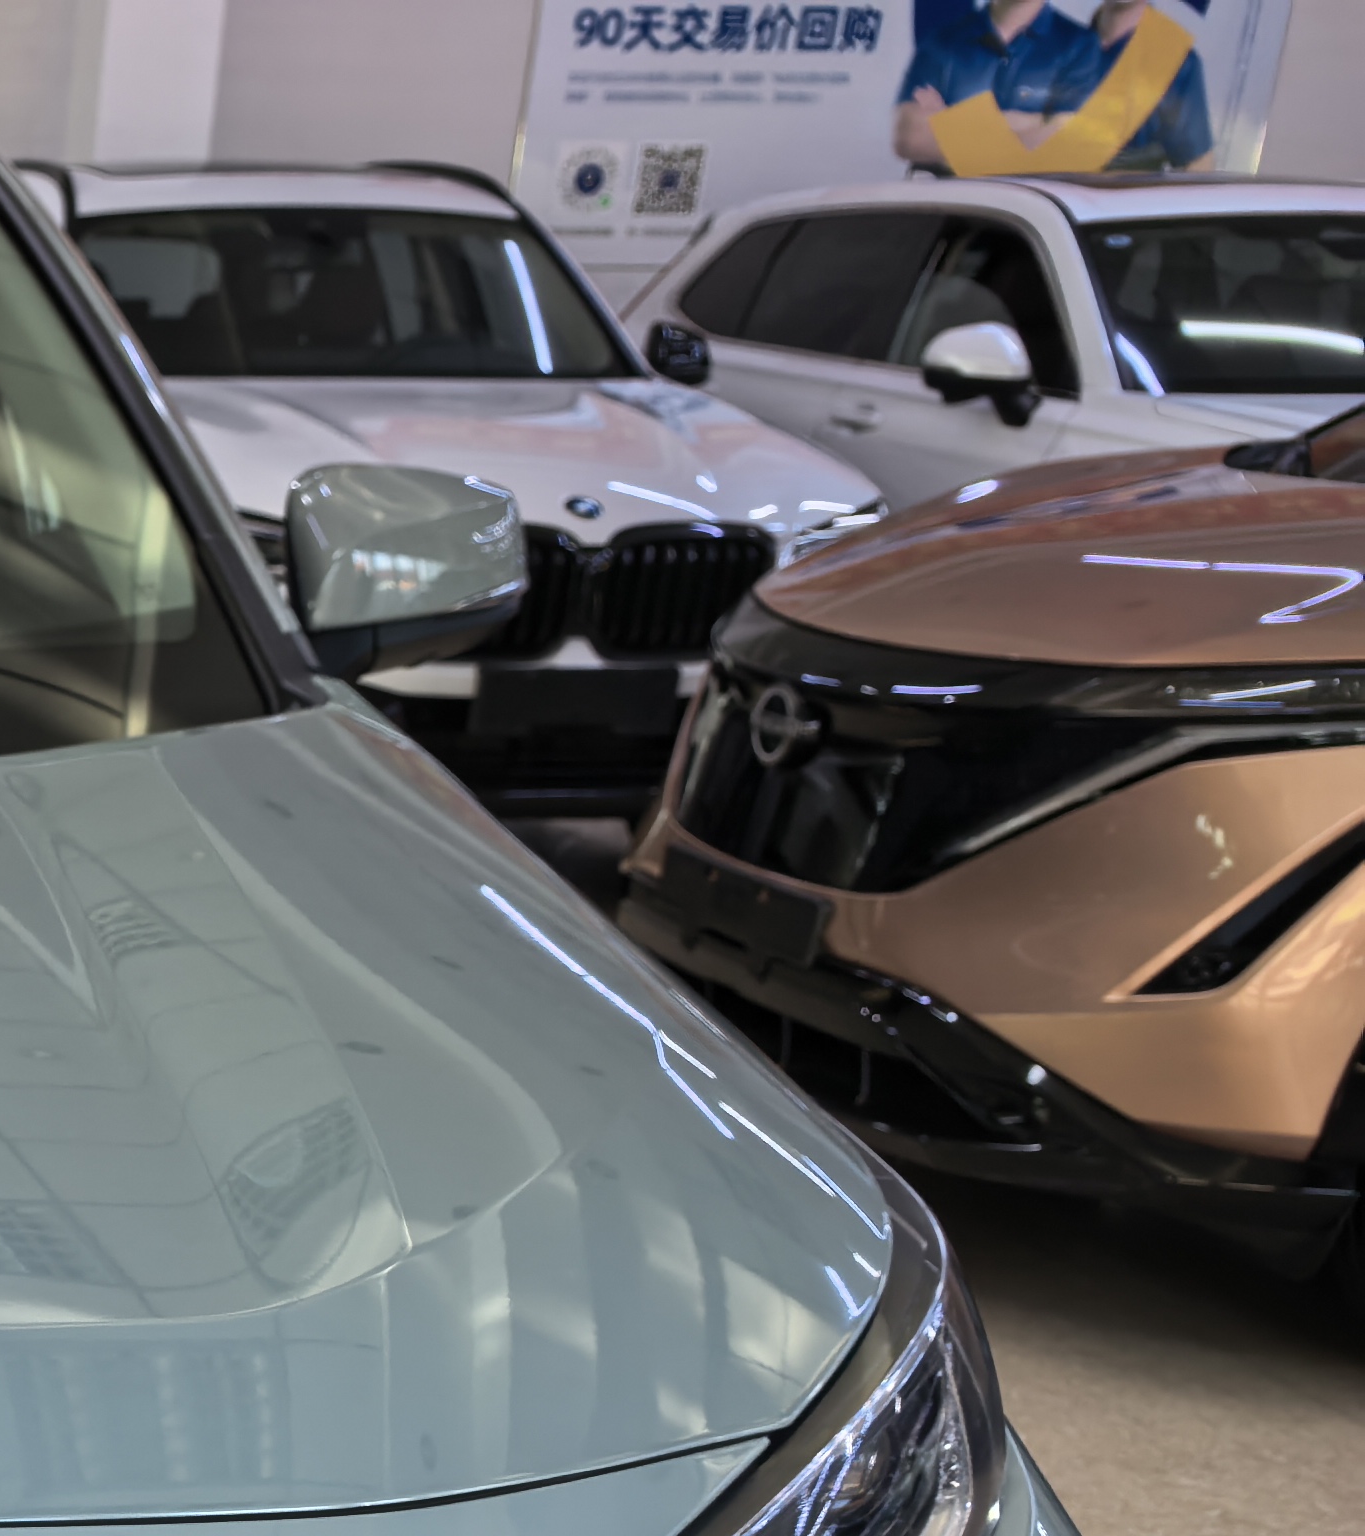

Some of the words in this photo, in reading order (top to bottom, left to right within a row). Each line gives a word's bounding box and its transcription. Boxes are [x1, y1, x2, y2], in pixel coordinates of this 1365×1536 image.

[572, 4, 883, 53] 90天交易价回购
